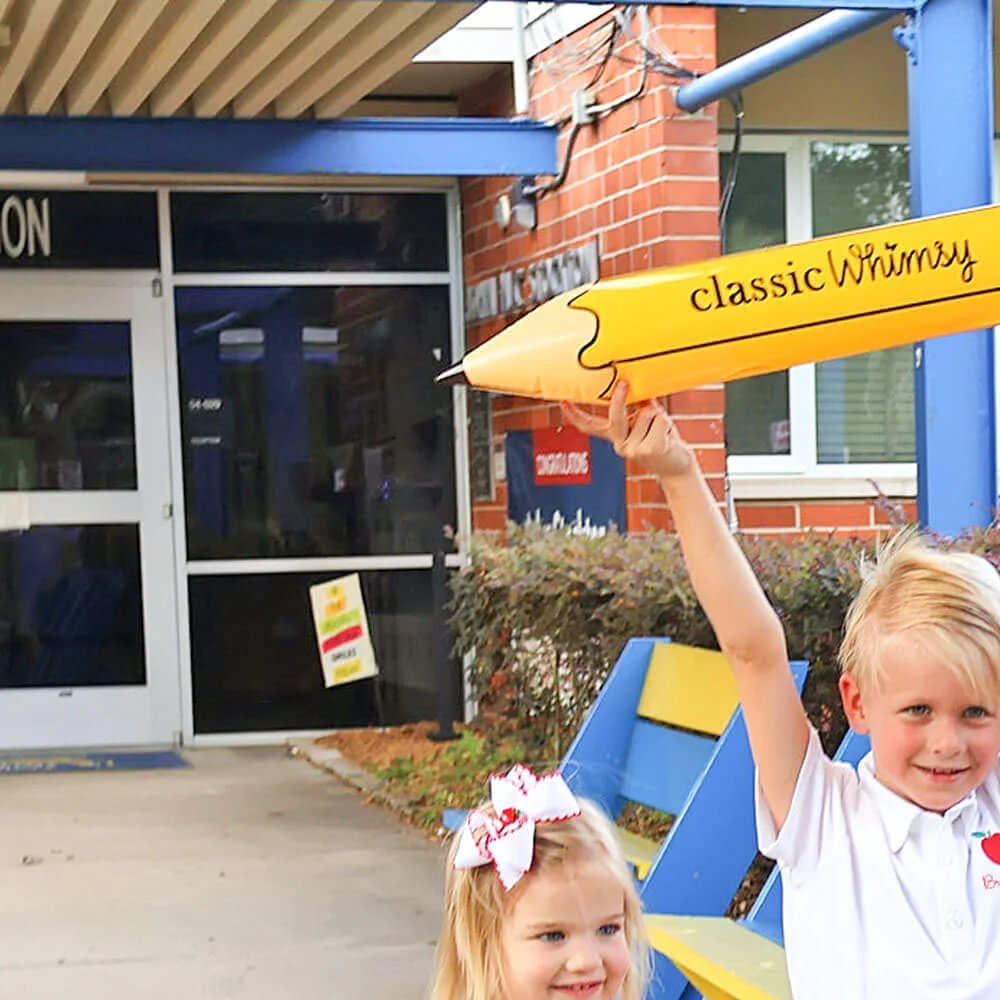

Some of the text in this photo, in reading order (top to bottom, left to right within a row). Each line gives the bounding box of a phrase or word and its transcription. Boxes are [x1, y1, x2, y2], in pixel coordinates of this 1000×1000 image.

[0, 195, 51, 258] ON
[690, 239, 977, 312] classic Whimsy
